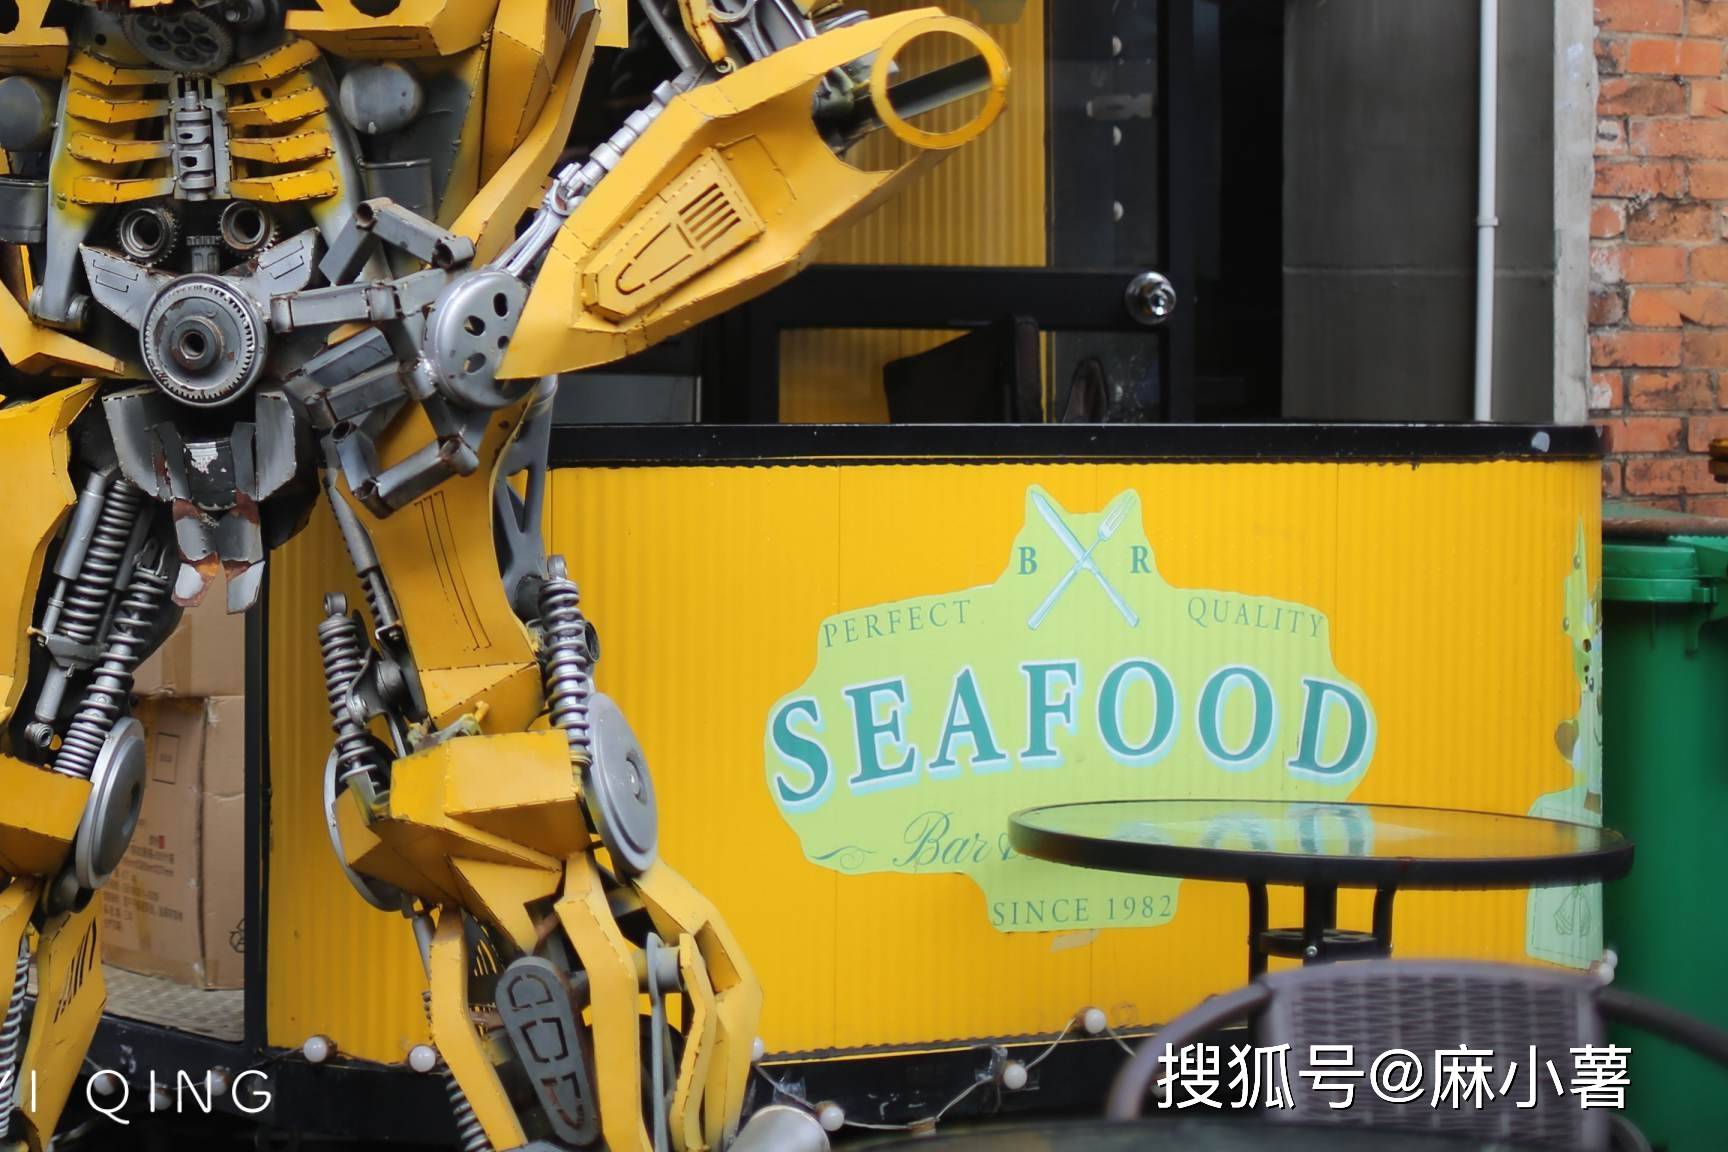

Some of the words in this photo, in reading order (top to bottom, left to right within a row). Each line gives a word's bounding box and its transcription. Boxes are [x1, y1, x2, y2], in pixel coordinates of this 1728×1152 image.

[1017, 546, 1038, 575] B
[1129, 545, 1152, 574] R
[823, 599, 971, 648] PERFECT
[1187, 596, 1325, 638] QUALITY
[770, 657, 1370, 804] SEAFOOD
[892, 811, 991, 868] Bar
[992, 896, 1090, 928] SINCE
[1106, 894, 1173, 921] 1982
